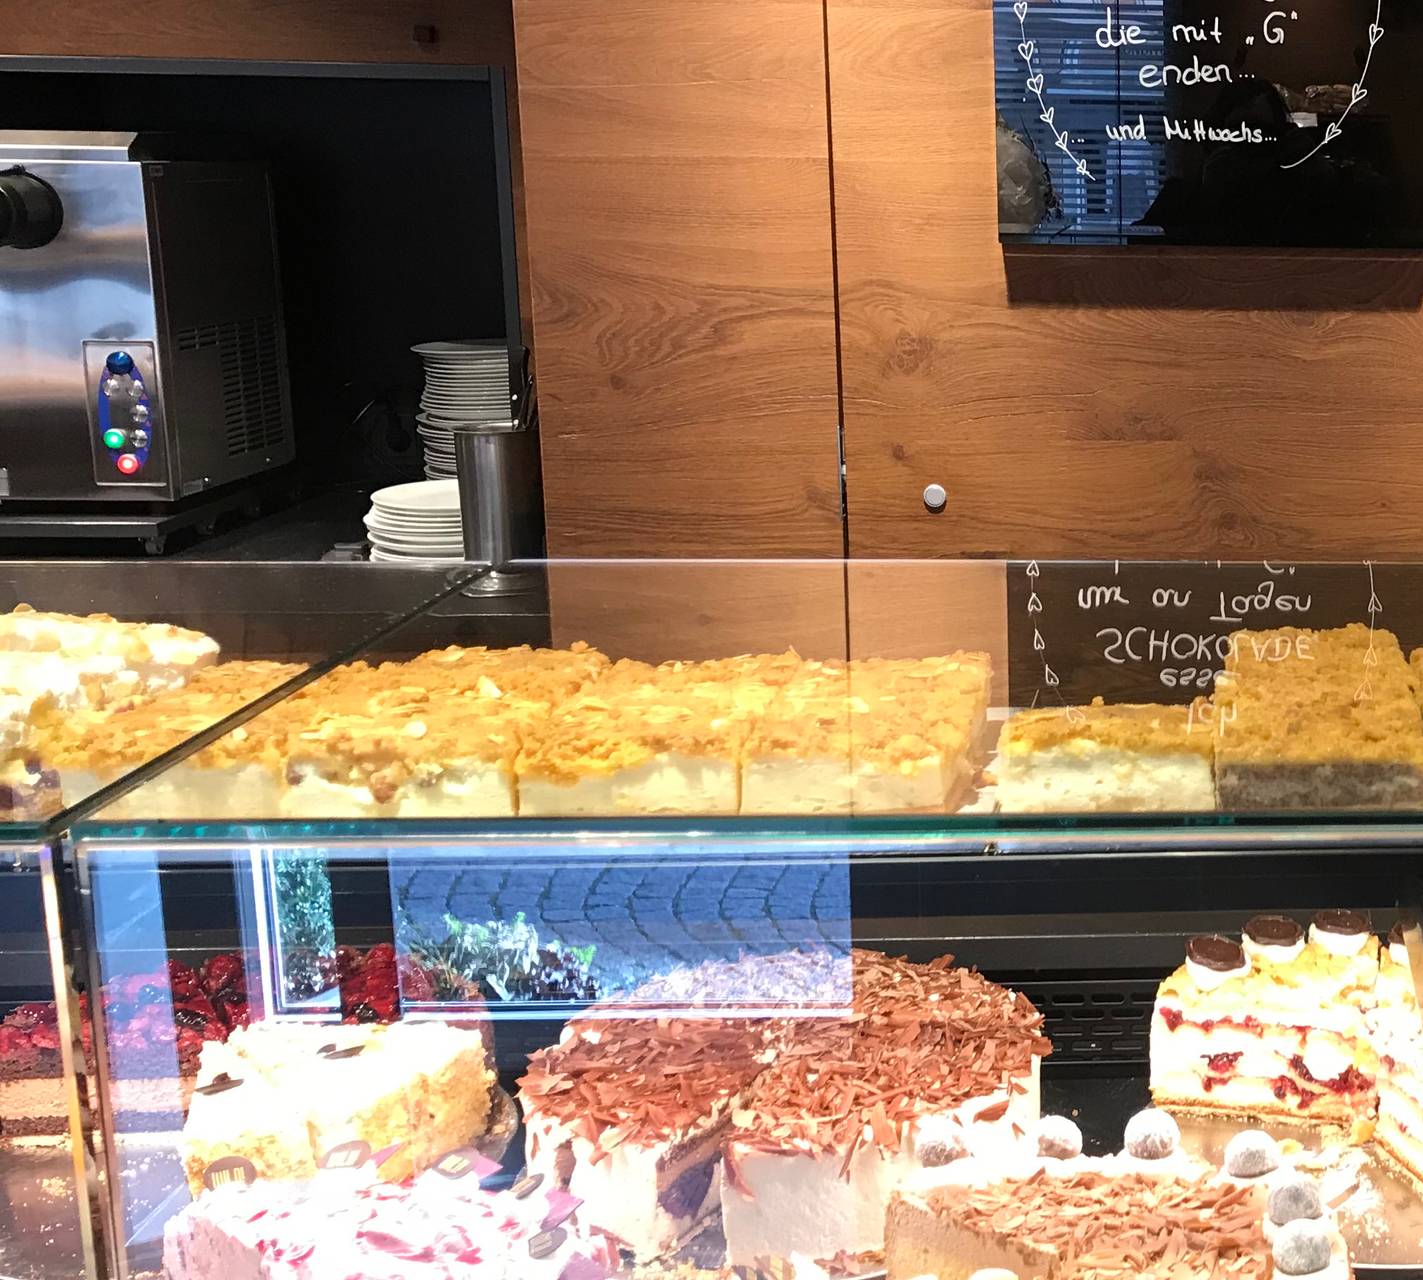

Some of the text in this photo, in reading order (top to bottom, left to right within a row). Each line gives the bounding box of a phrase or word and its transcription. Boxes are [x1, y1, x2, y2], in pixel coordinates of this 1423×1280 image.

[1095, 7, 1146, 47] die
[1173, 17, 1223, 44] mit
[1138, 55, 1255, 88] enden...
[1106, 115, 1146, 141] und
[1163, 116, 1278, 144] Mittwochs...
